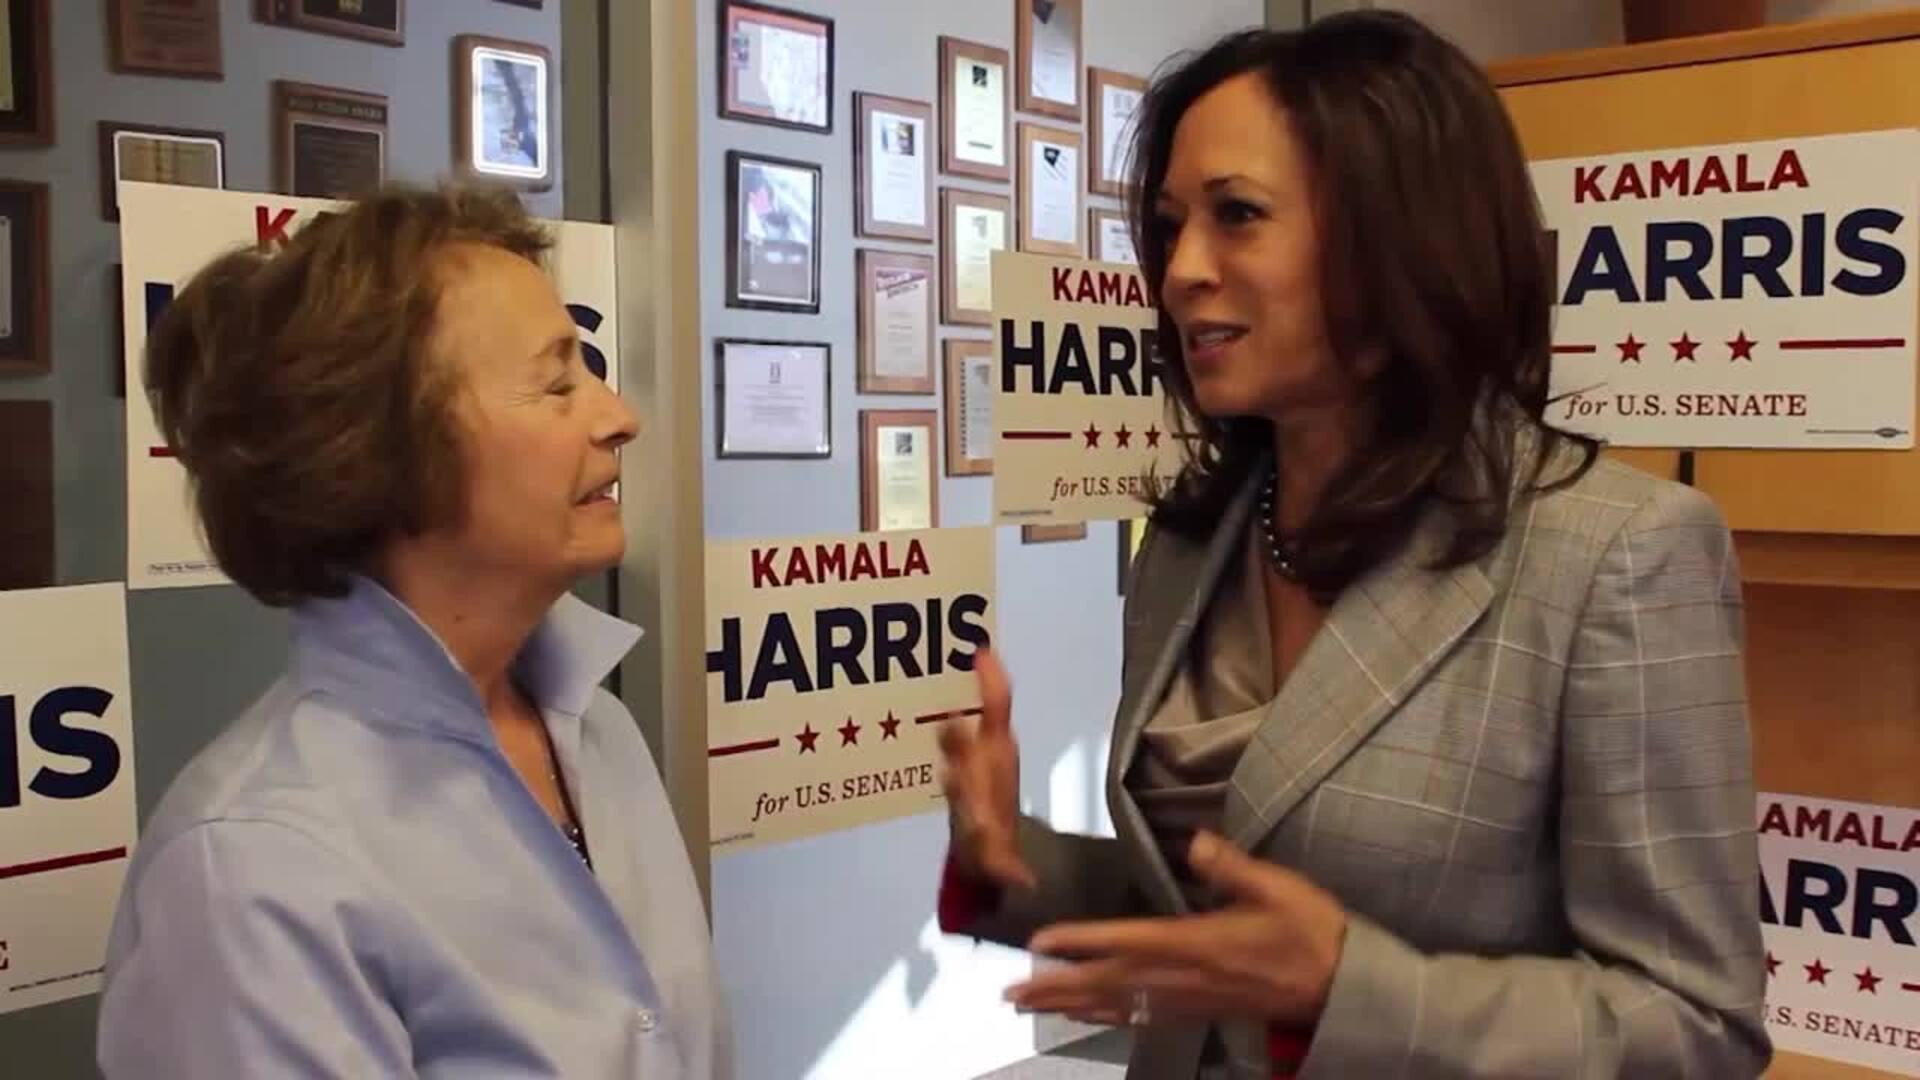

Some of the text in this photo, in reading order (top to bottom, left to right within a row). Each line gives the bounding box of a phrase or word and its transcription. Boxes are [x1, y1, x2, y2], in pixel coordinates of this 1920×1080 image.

[1574, 149, 1809, 203] KAMALA
[1565, 394, 1807, 420] for U.S. SENATE
[1050, 477, 1078, 501] for
[1082, 477, 1112, 496] U.S.
[751, 539, 931, 589] KAMALA
[705, 594, 991, 702] HARRIS
[752, 763, 933, 821] for U.S. SENATE
[1805, 1011, 1920, 1051] SENATE
